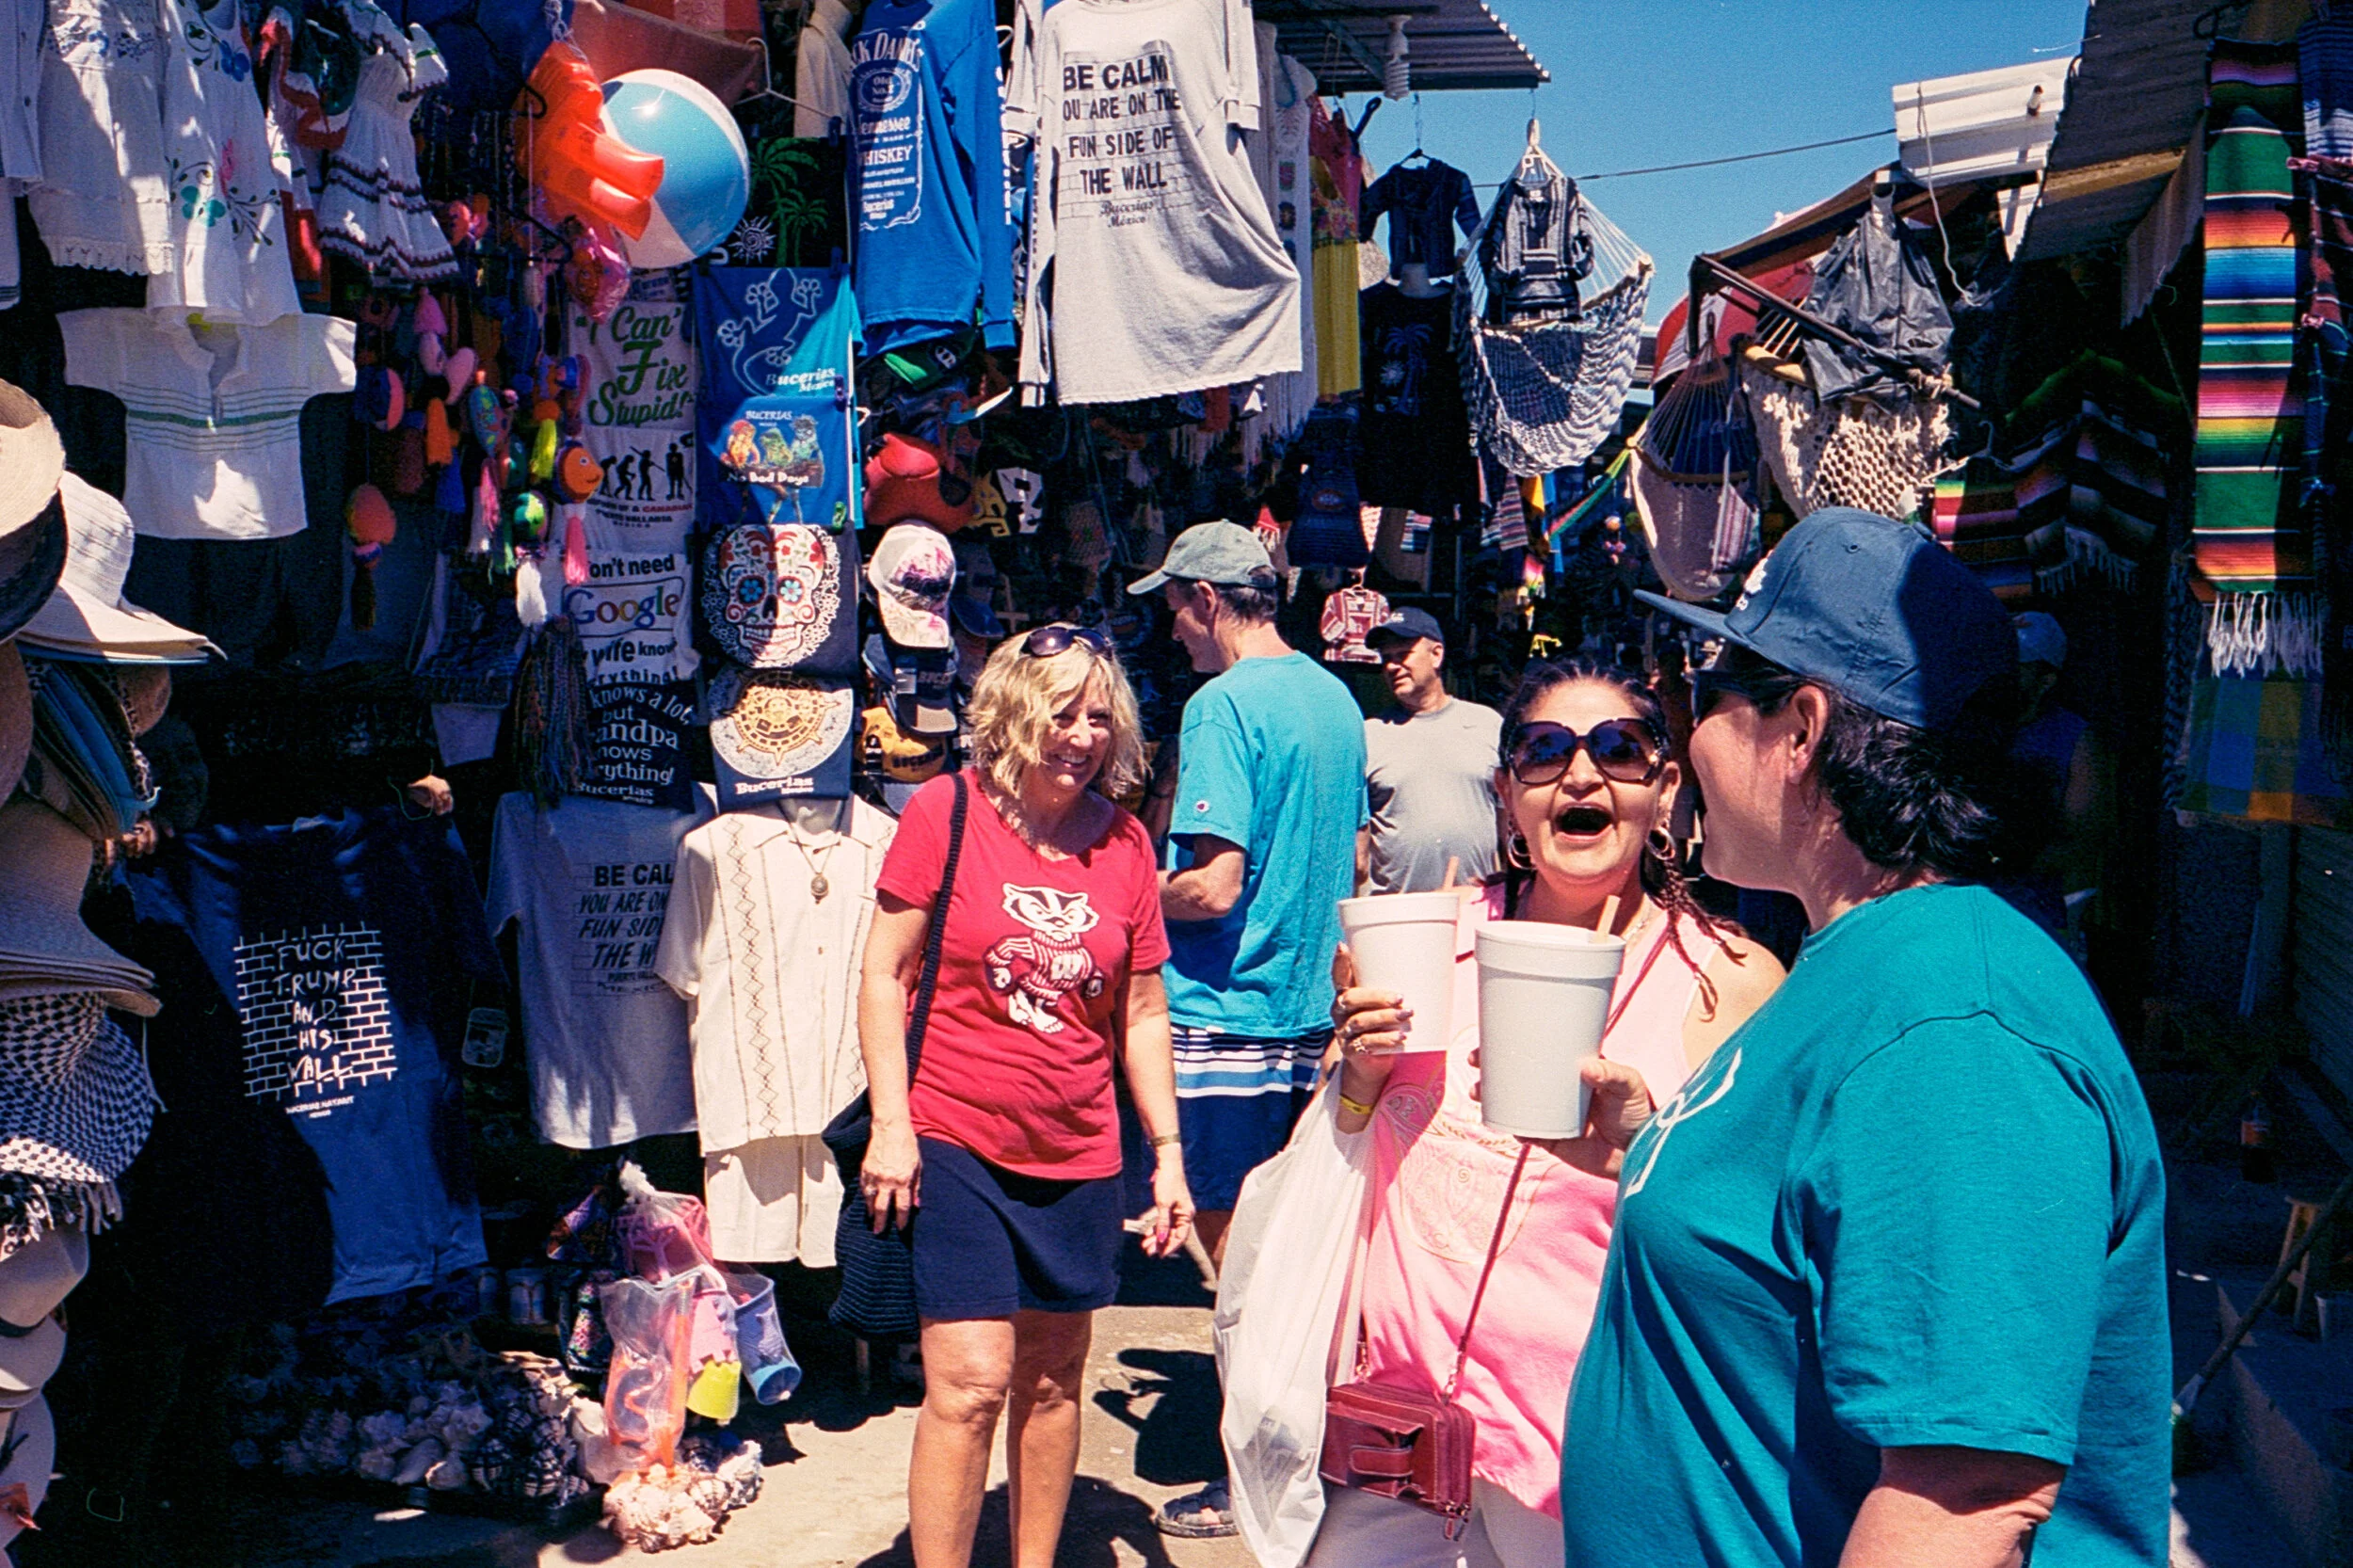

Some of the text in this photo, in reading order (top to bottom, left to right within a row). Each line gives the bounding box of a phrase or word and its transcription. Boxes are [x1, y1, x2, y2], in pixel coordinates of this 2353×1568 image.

[1063, 55, 1169, 91] BE CALM
[1063, 98, 1080, 121] OU
[1089, 96, 1120, 120] ARE
[1128, 91, 1147, 117] ON
[1068, 125, 1173, 158] FUN SIDE OF
[1080, 160, 1168, 196] THE WALL
[616, 338, 690, 396] Fix
[764, 368, 837, 387] Bucerias
[748, 472, 776, 483] Bad
[777, 471, 810, 486] Days
[589, 553, 676, 578] on't need
[565, 584, 682, 630] Google
[589, 684, 648, 709] knows
[648, 692, 664, 711] a
[601, 705, 634, 724] but
[594, 717, 681, 751] andpa
[601, 745, 653, 761] nows
[734, 776, 814, 795] Bucerias
[594, 863, 676, 888] BE CAL
[578, 893, 611, 915] YOU
[613, 891, 648, 914] ARE
[578, 918, 624, 939] FUN
[277, 937, 347, 970] FUCK
[591, 942, 636, 968] THE
[272, 968, 357, 997] TRUMP
[292, 998, 337, 1026] AND
[297, 1029, 334, 1052] HIS
[286, 1054, 354, 1081] WALL
